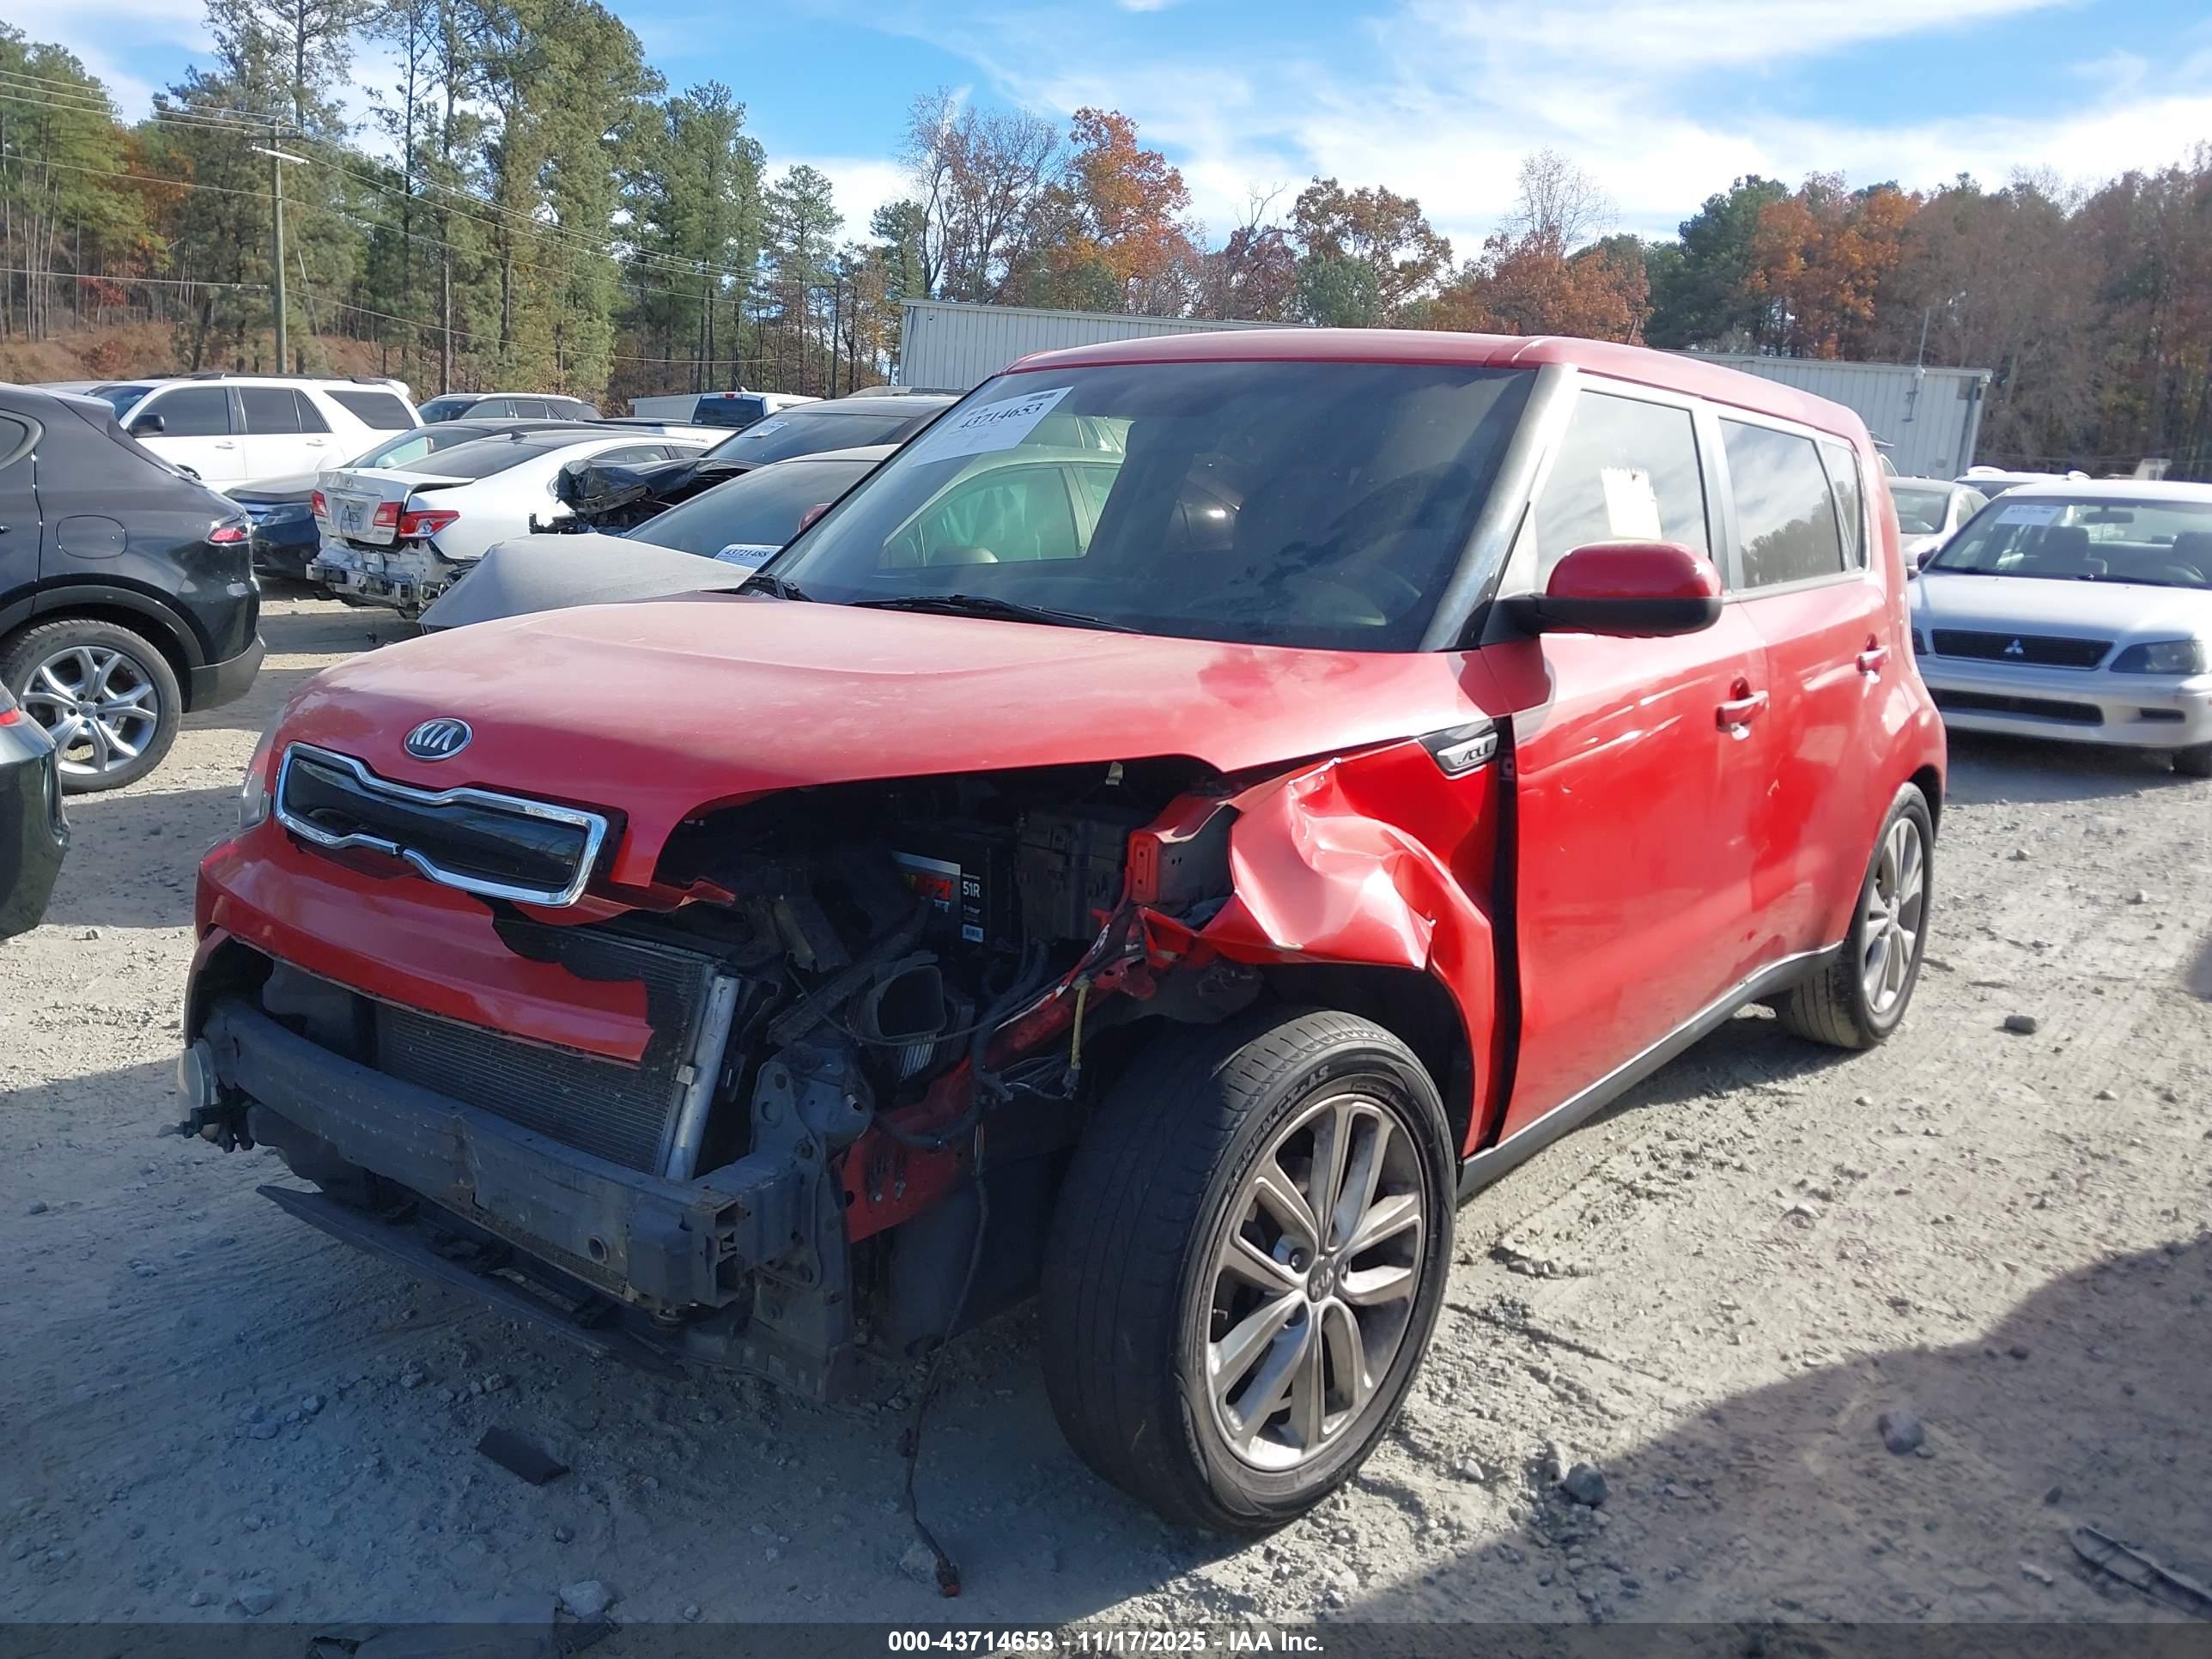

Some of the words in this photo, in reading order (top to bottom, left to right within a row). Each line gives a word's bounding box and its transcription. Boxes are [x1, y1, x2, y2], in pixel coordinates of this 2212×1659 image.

[959, 402, 1044, 428] 43714653
[408, 723, 459, 752] KIA
[963, 880, 981, 898] 51R
[1310, 1267, 1334, 1301] KIA
